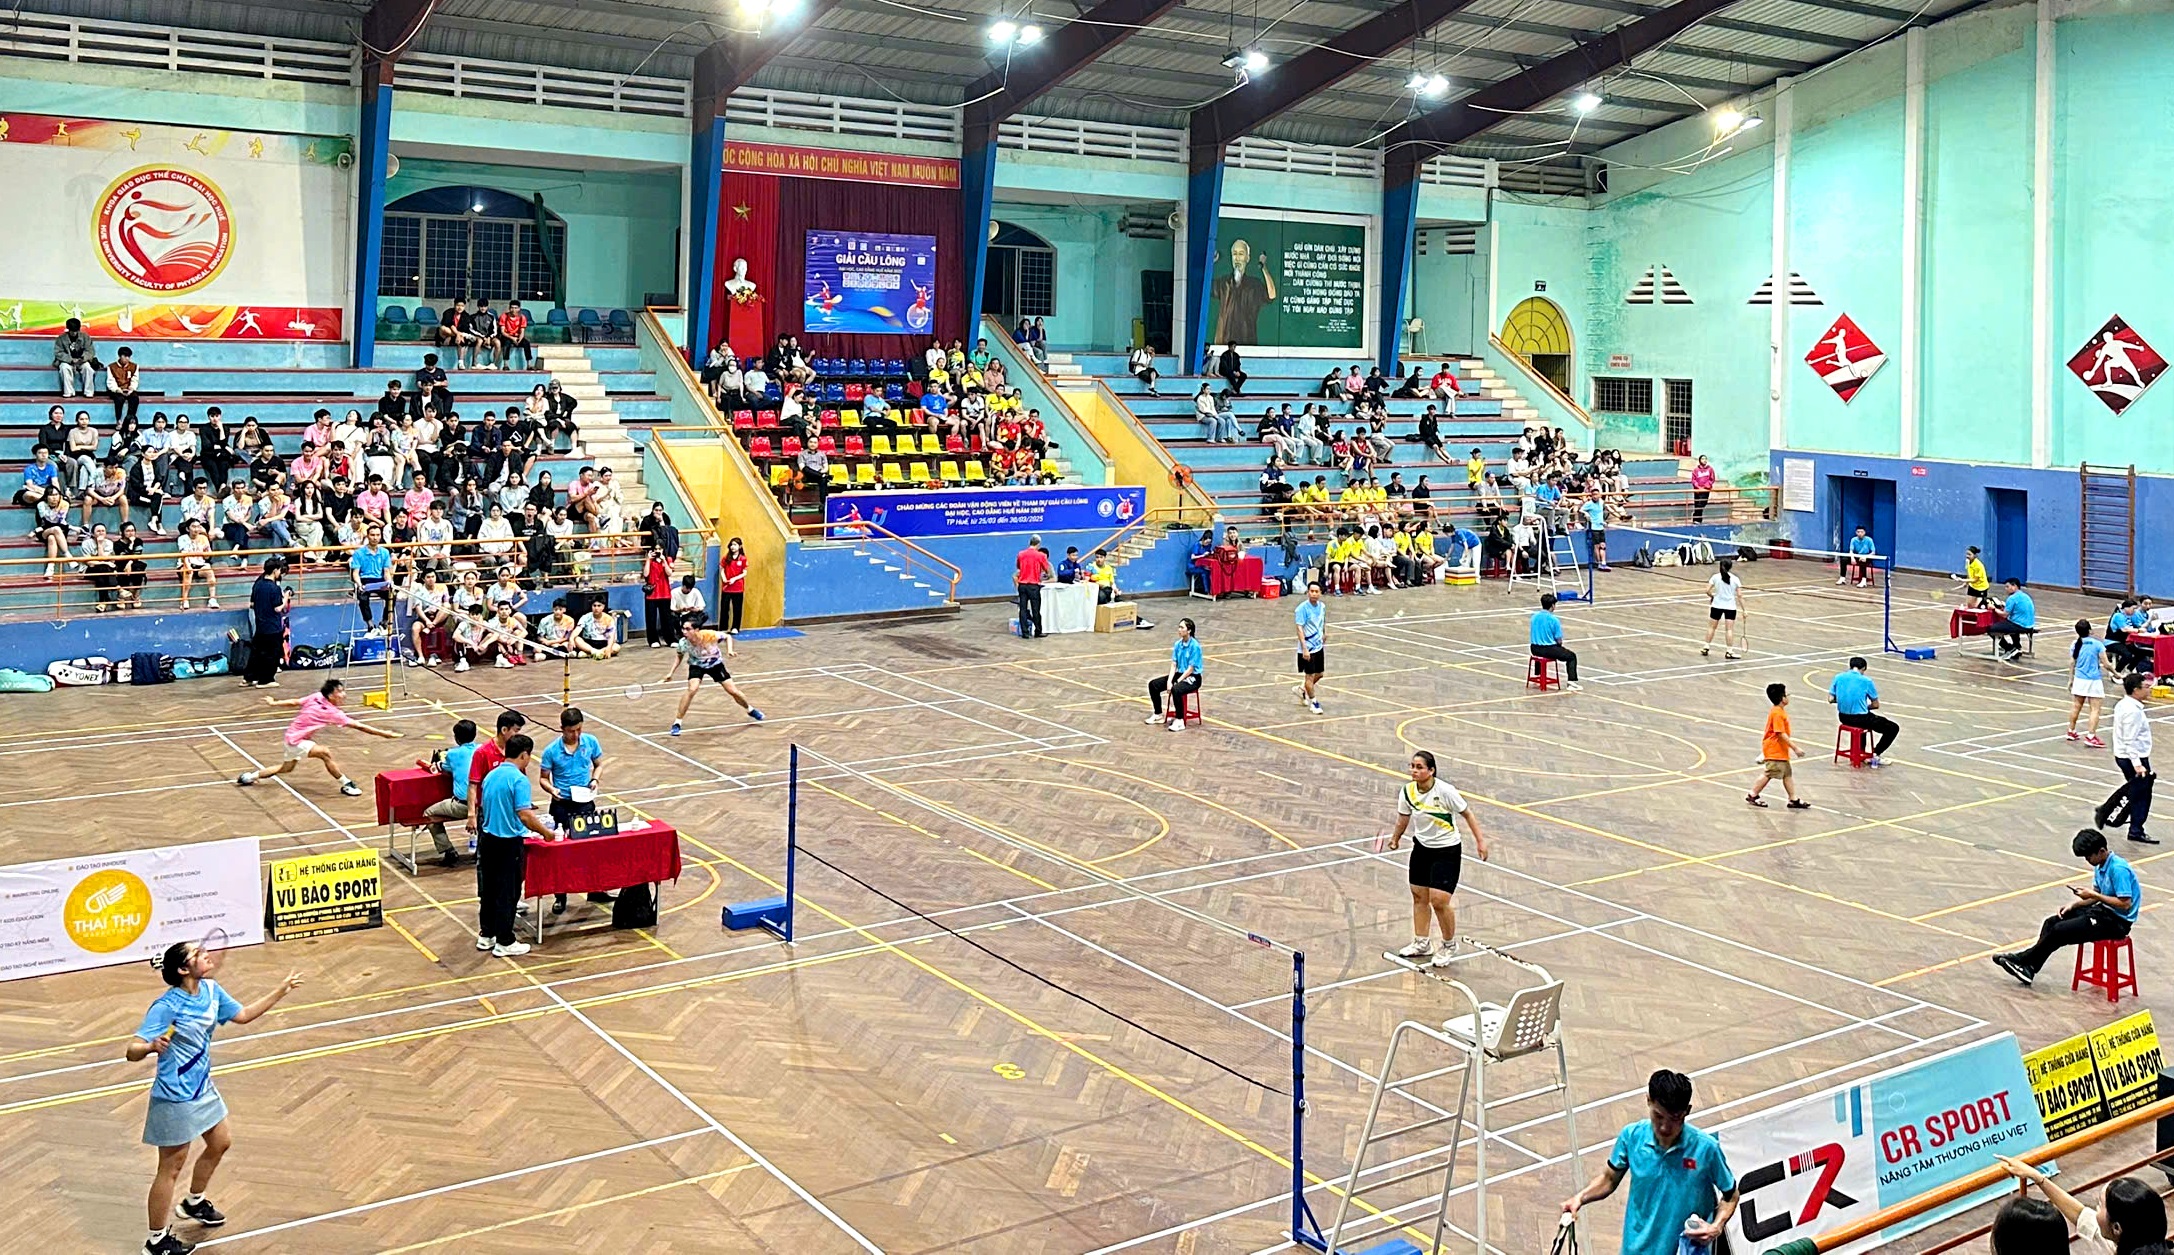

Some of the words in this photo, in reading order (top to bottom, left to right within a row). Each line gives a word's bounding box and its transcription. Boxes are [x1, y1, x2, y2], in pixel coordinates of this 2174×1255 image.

[738, 149, 763, 172] CỘNG
[766, 150, 785, 169] HÒA
[788, 151, 800, 170] XÃ
[802, 152, 818, 176] HỘI
[821, 152, 839, 173] CHỦ
[842, 156, 868, 176] NGHĨA
[870, 158, 888, 180] VIỆT
[891, 165, 910, 178] NAM
[912, 162, 936, 180] MUÔN
[938, 164, 956, 182] NĂM
[104, 194, 119, 215] KHOA
[117, 182, 134, 195] GIÁO
[135, 173, 151, 184] DỤC
[153, 170, 169, 179] THỂ
[171, 172, 191, 183] CHẤT
[193, 180, 205, 193] ĐẠI
[205, 191, 217, 206] HỌC
[216, 204, 227, 221] HUẾ
[102, 241, 130, 278] UNIVERSITY
[130, 276, 164, 289] FACULTY
[177, 269, 210, 288] PHYSICAL
[209, 232, 228, 270] EDUCATION
[836, 252, 855, 264] GIẢI
[858, 252, 877, 265] CẦU
[880, 254, 906, 266] LÔNG
[935, 502, 948, 510] CÁC
[314, 654, 339, 667] YONEX
[75, 673, 98, 681] YONEX
[602, 814, 613, 828] 0
[300, 866, 309, 877] HỆ
[339, 858, 354, 870] CỬA
[356, 857, 376, 868] HÀNG
[335, 877, 377, 900] SPORT
[112, 912, 141, 928] THU
[2136, 1048, 2163, 1079] SPORT
[2067, 1073, 2097, 1106] SPORT
[1880, 1124, 1922, 1164] CR
[1925, 1091, 2012, 1148] SPORT
[1880, 1165, 1911, 1185] NÂNG
[1912, 1156, 1935, 1176] TẦM
[1936, 1140, 1981, 1165] THƯƠNG
[1982, 1131, 2005, 1150] HIỆU
[2006, 1122, 2029, 1140] VIỆT
